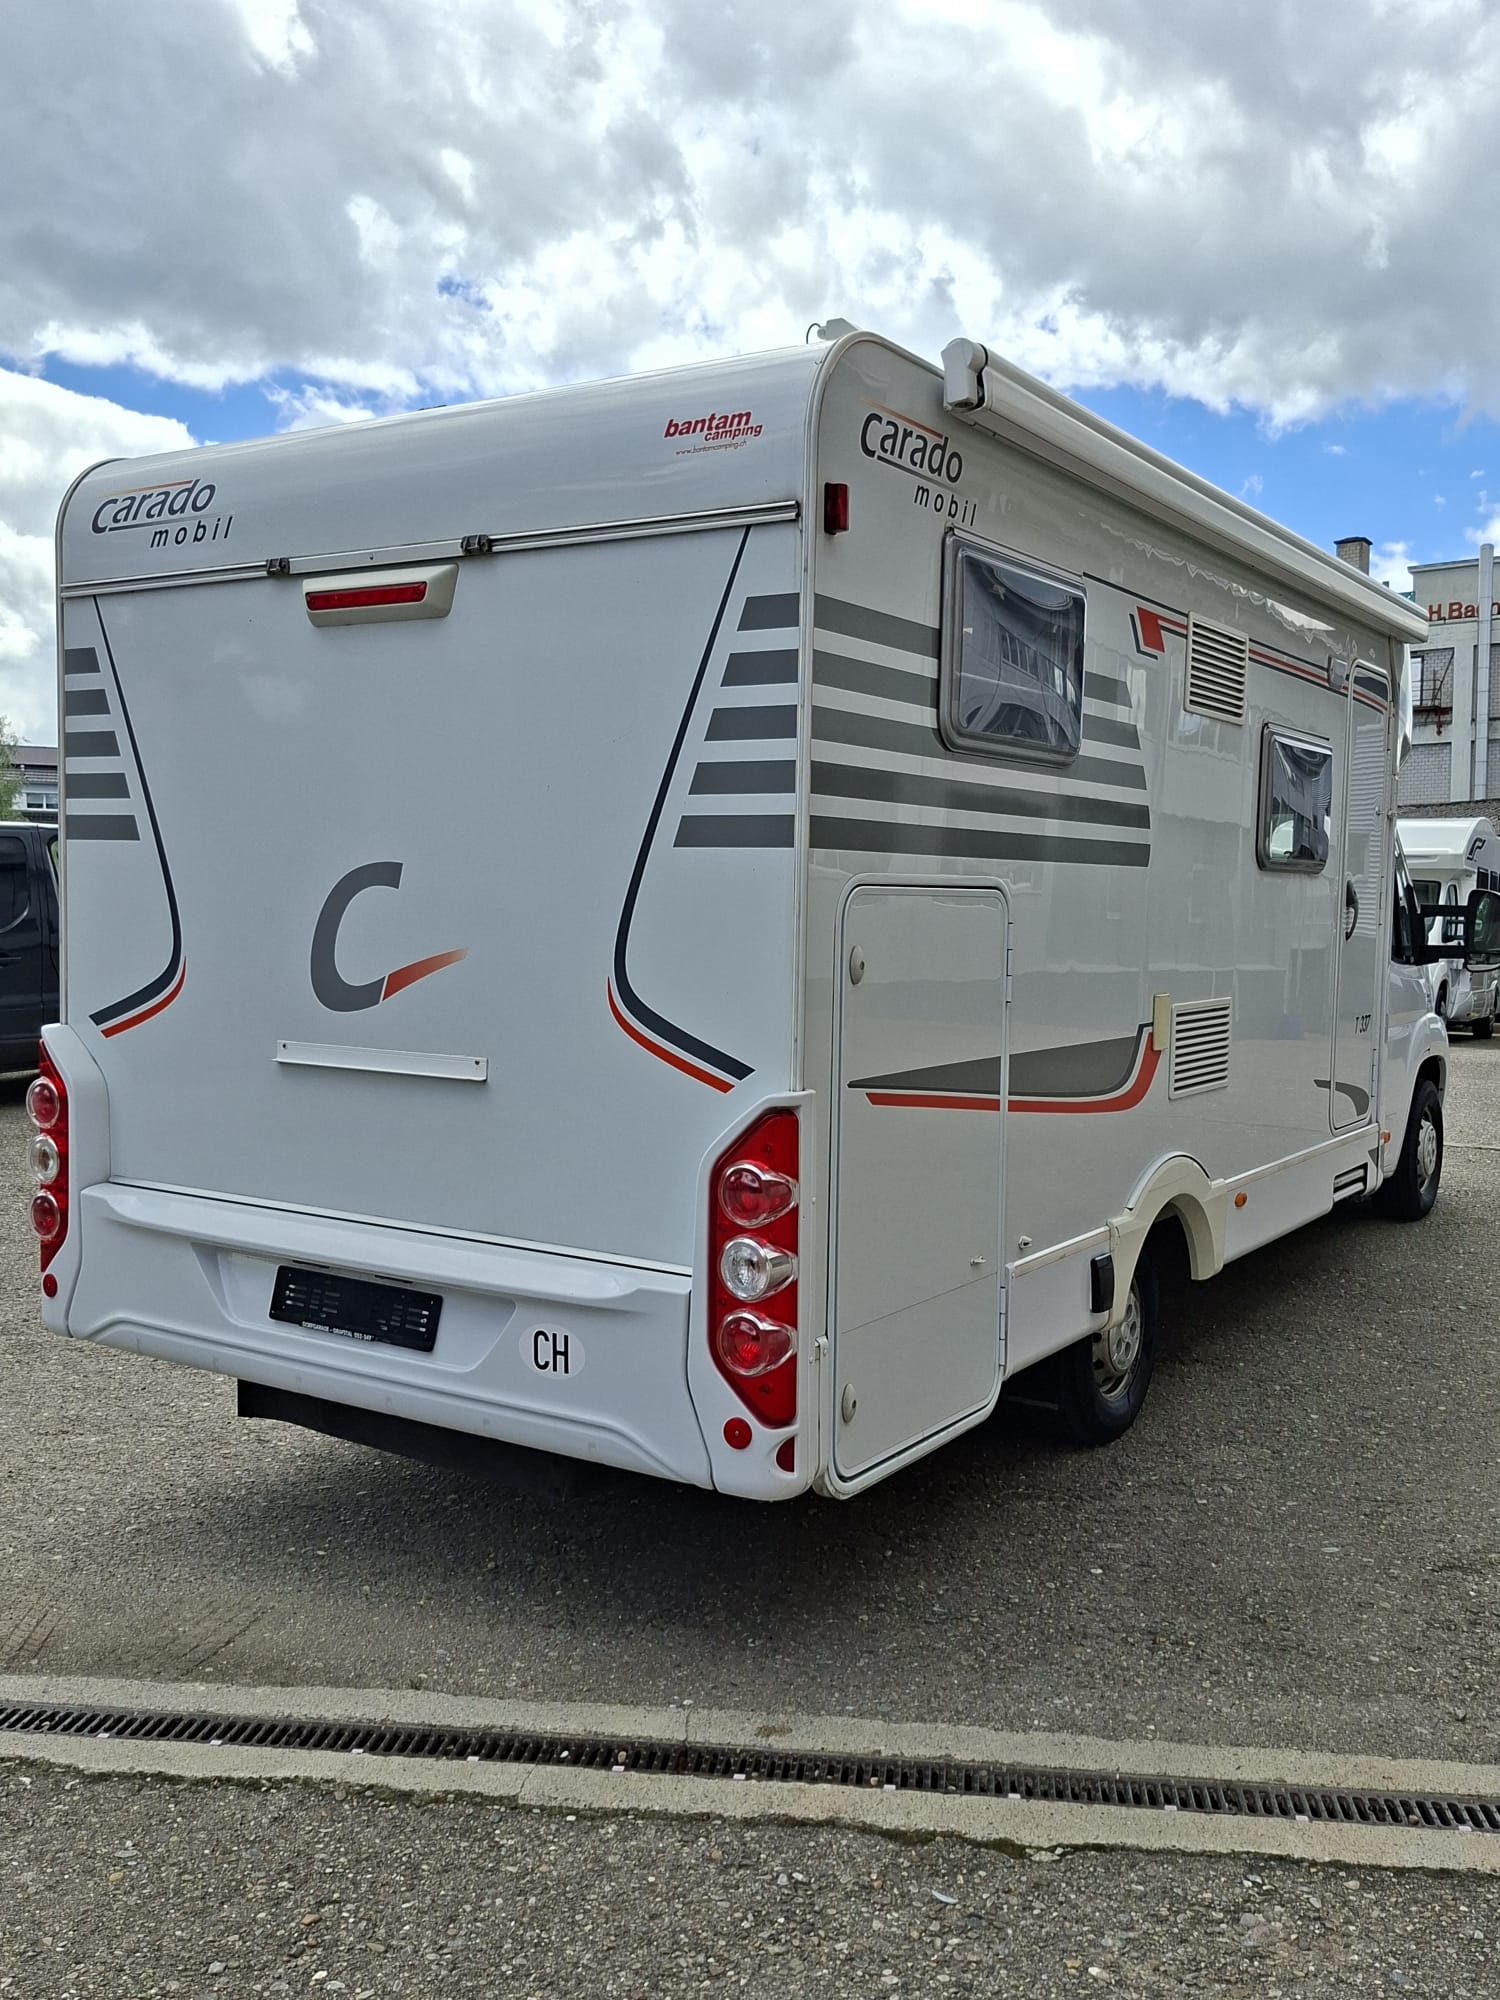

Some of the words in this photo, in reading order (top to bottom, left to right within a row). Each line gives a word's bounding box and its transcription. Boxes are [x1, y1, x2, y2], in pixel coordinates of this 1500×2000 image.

[664, 411, 752, 438] bantam
[704, 424, 763, 441] camping
[913, 484, 977, 527] mobil
[150, 516, 233, 548] mobil
[533, 1330, 569, 1374] CH
